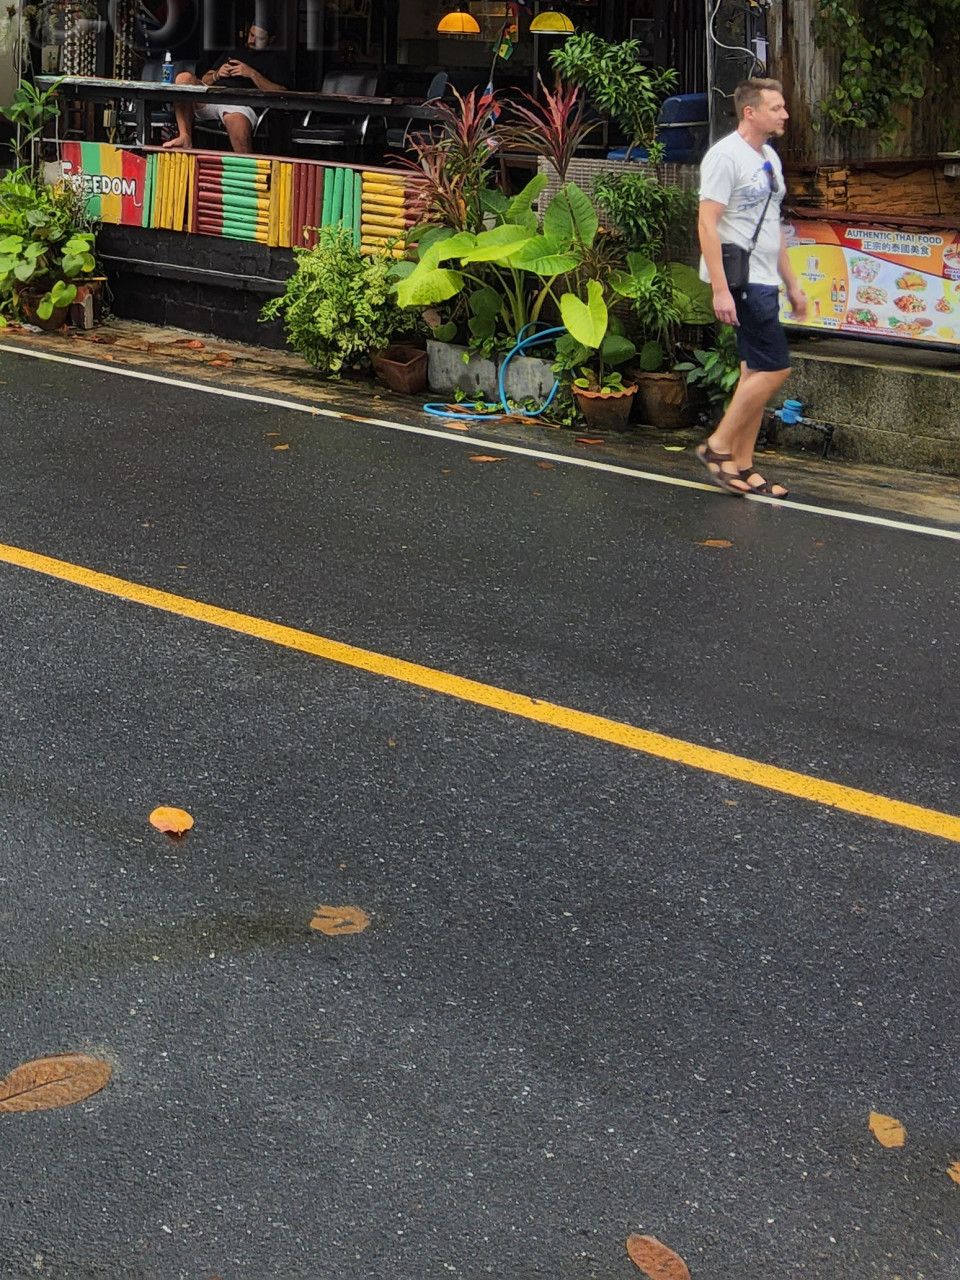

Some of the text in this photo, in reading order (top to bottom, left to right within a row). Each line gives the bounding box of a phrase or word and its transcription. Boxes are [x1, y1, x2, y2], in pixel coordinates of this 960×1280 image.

[846, 228, 943, 244] AUTHENTIC THAI FOOD
[863, 241, 931, 256] 正宗的泰國美食
